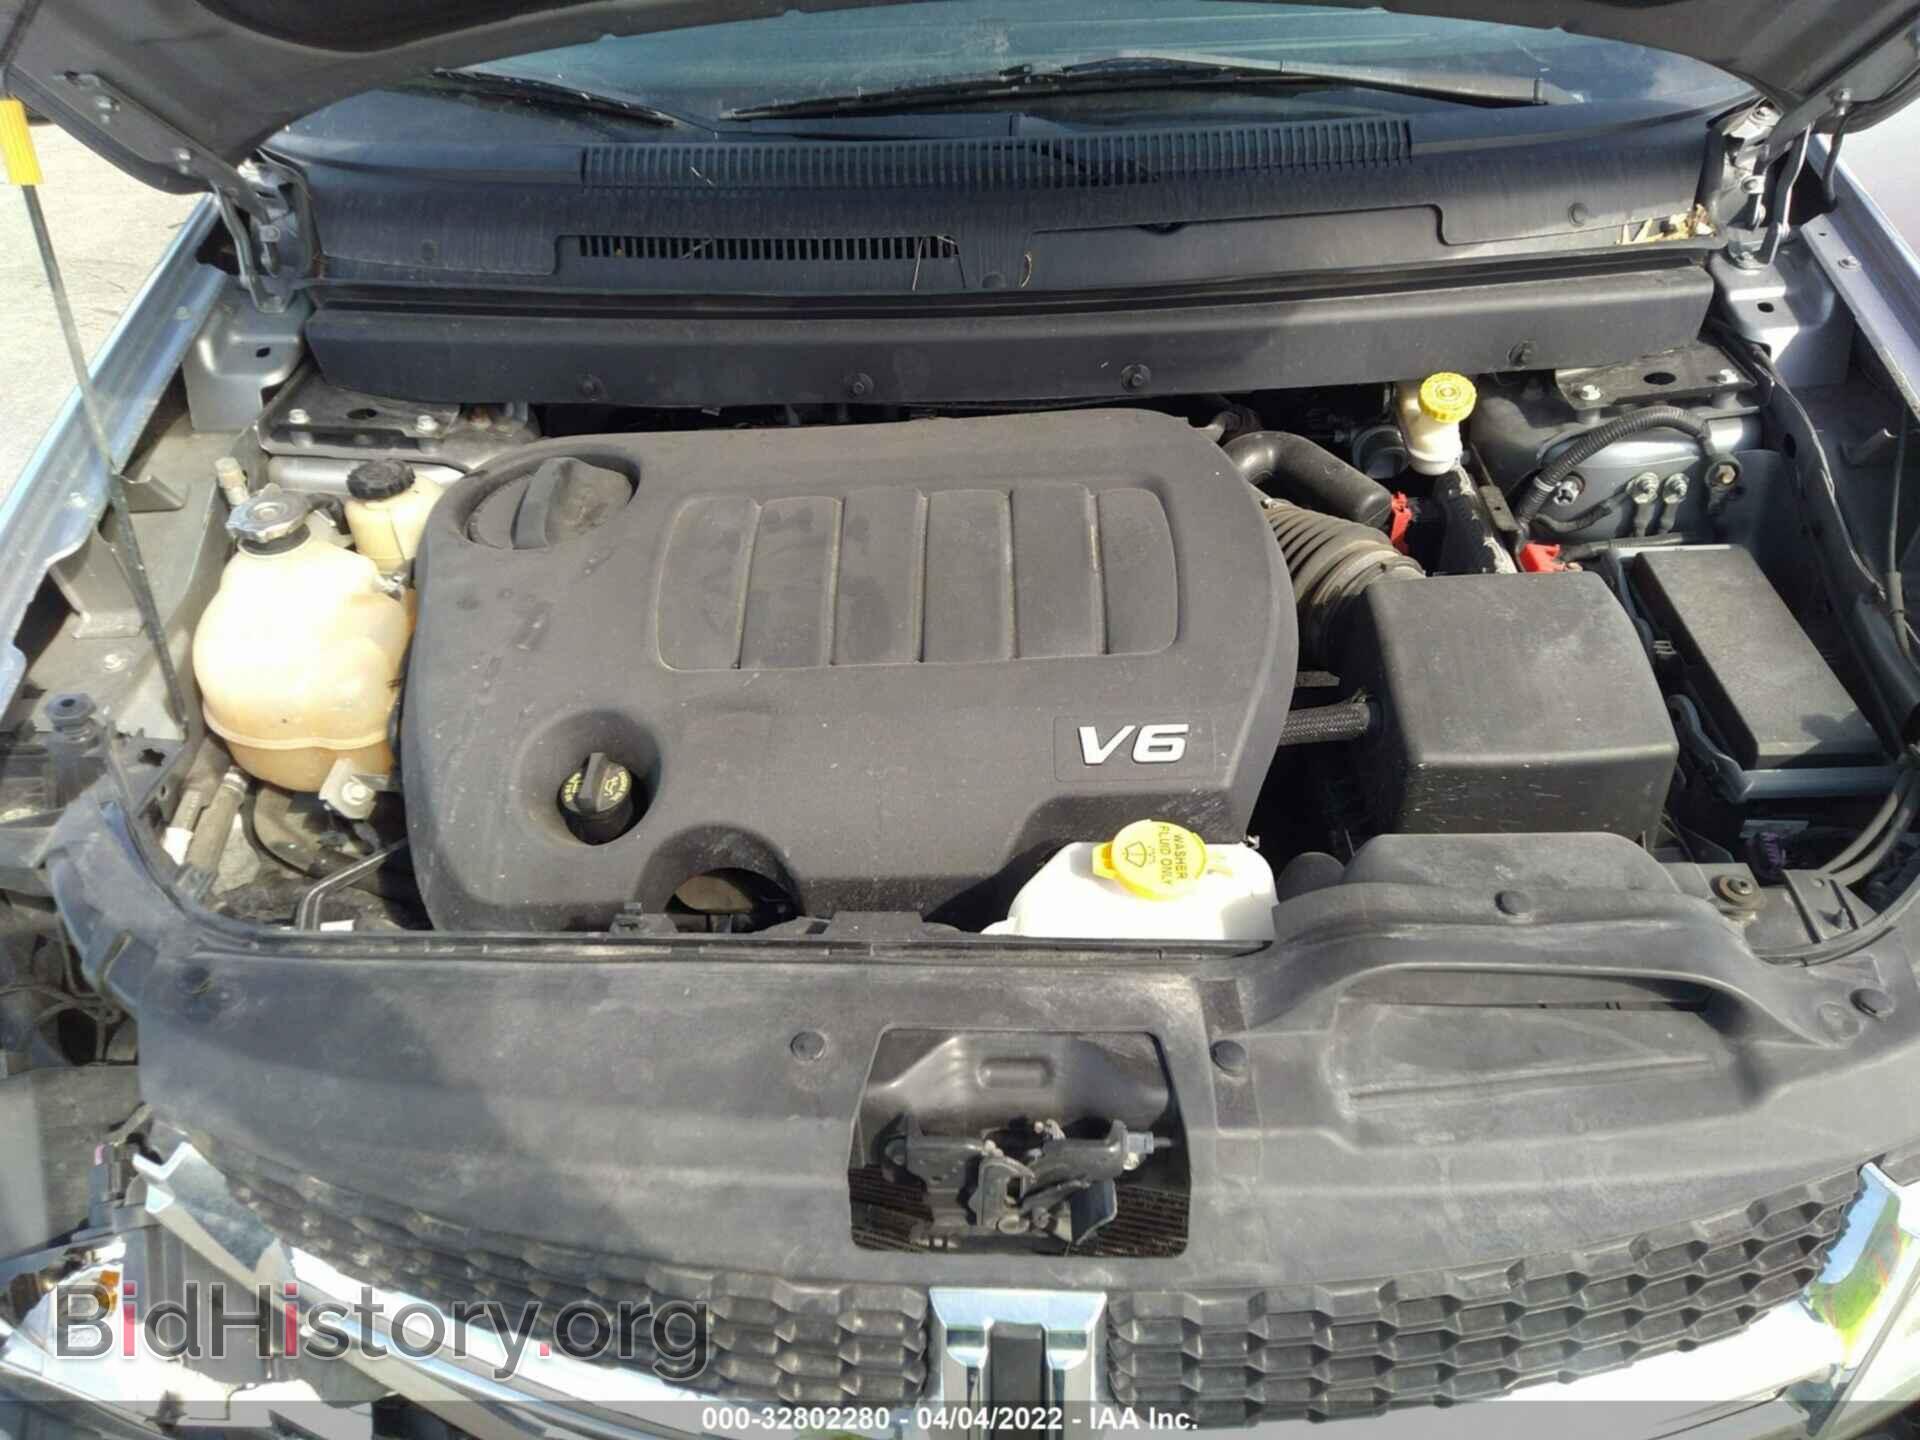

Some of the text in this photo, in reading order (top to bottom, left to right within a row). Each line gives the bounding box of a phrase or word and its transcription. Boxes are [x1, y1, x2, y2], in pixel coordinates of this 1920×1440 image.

[1078, 724, 1189, 765] V6
[1158, 825, 1174, 885] FLUID ONLY
[1173, 834, 1188, 880] WASHER
